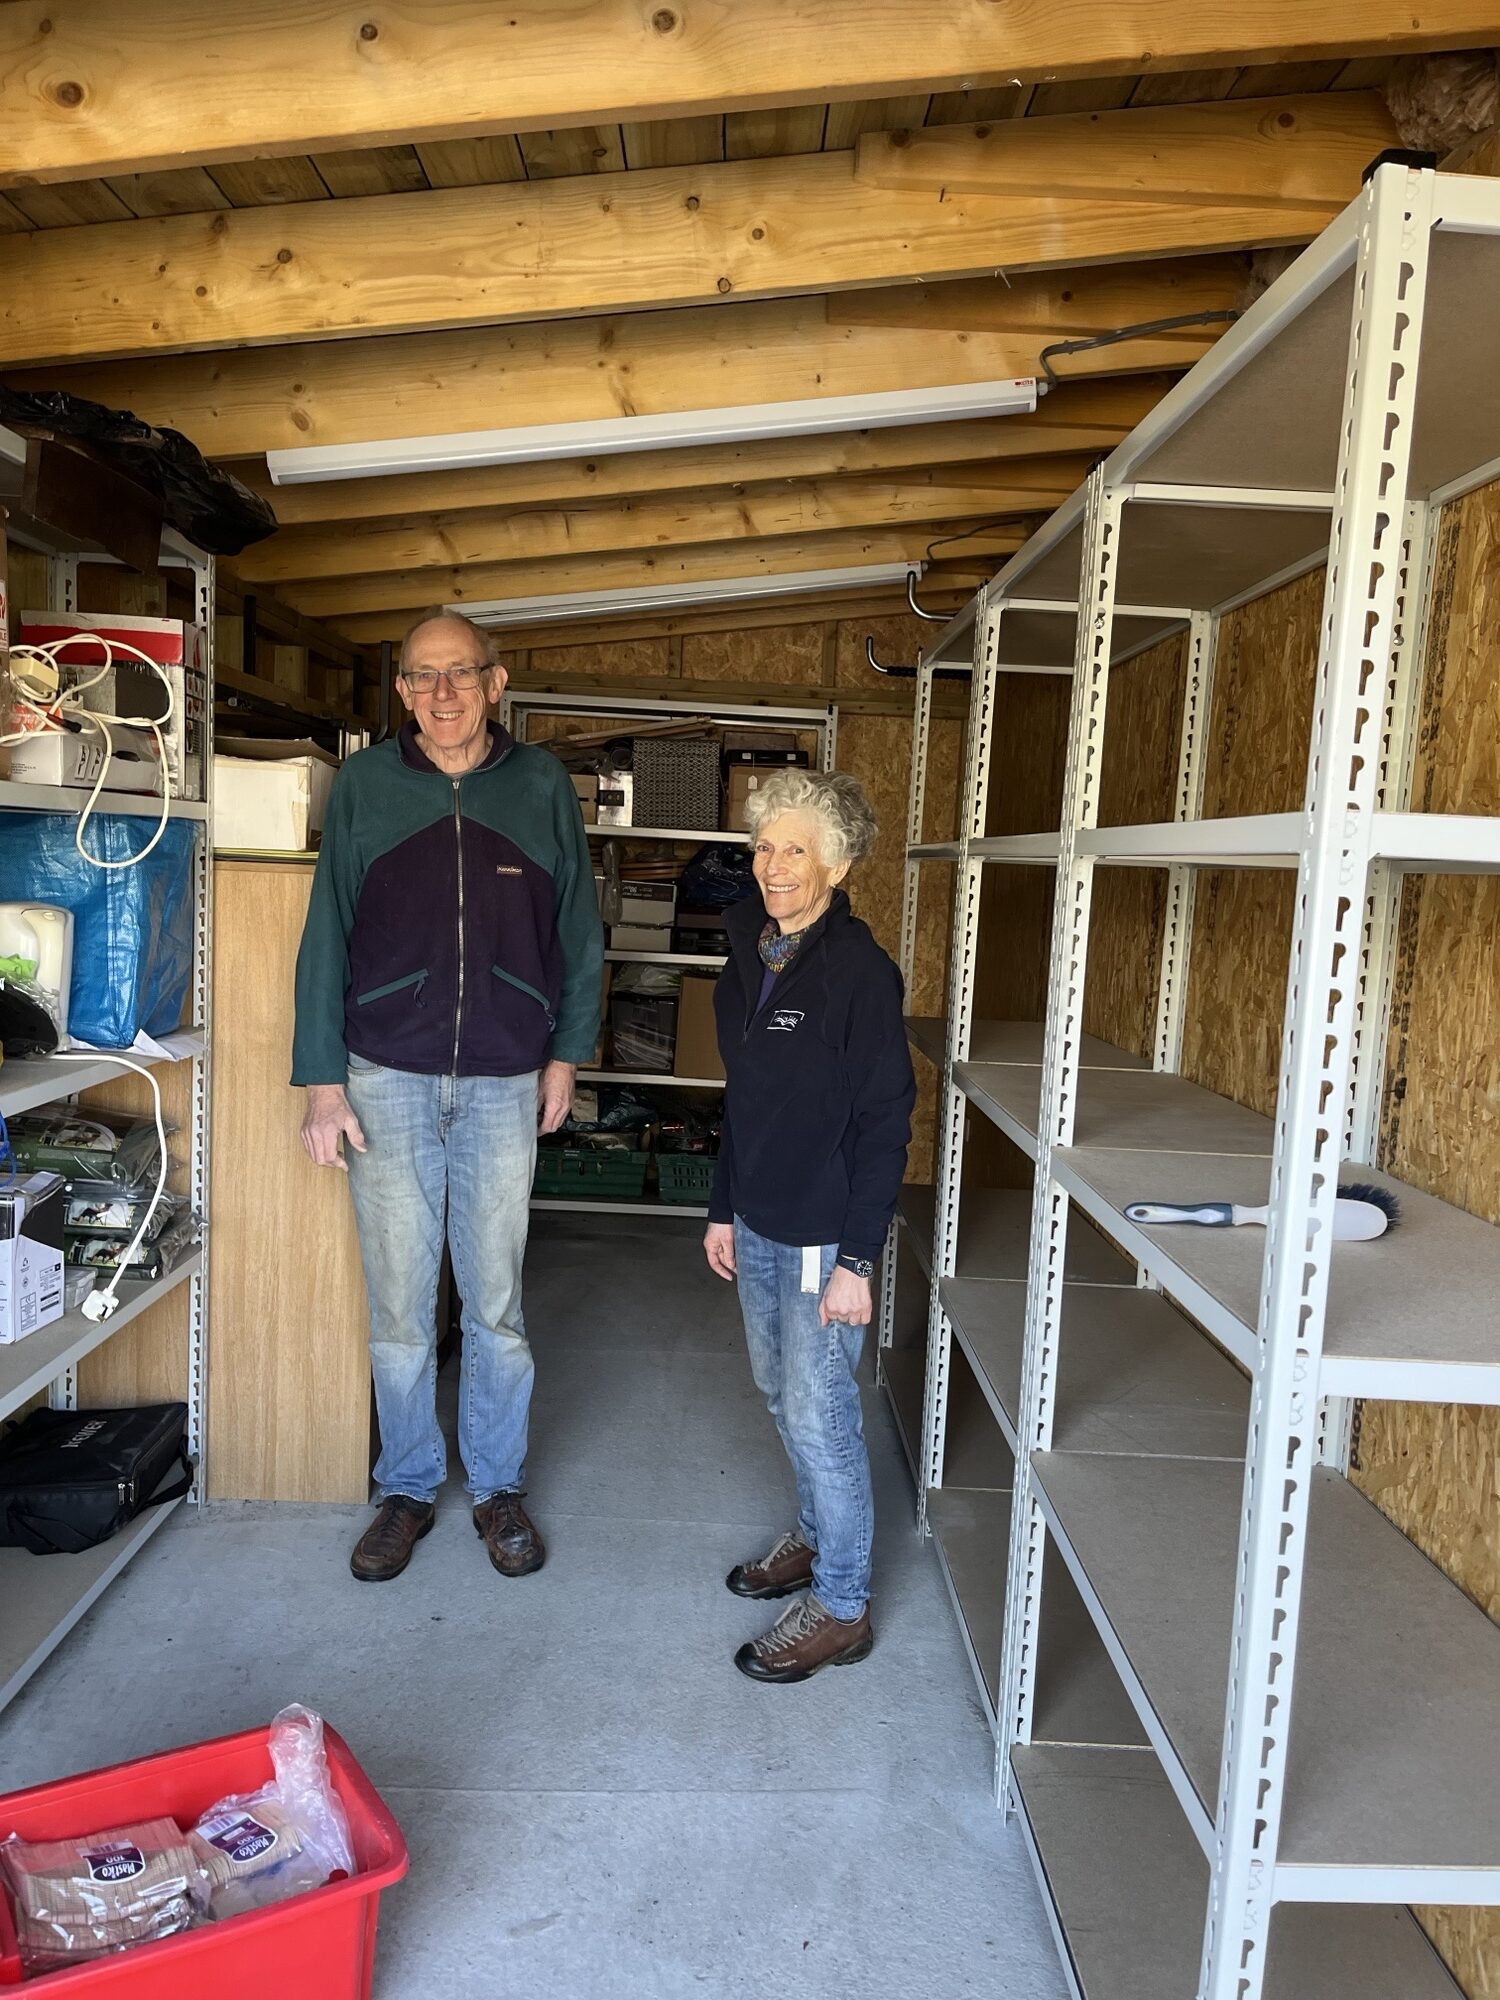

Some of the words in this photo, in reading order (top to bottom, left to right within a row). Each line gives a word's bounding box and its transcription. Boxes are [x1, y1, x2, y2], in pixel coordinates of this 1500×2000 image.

[238, 1836, 270, 1857] Plastico
[105, 1854, 126, 1864] 100
[101, 1861, 136, 1879] Plastico
